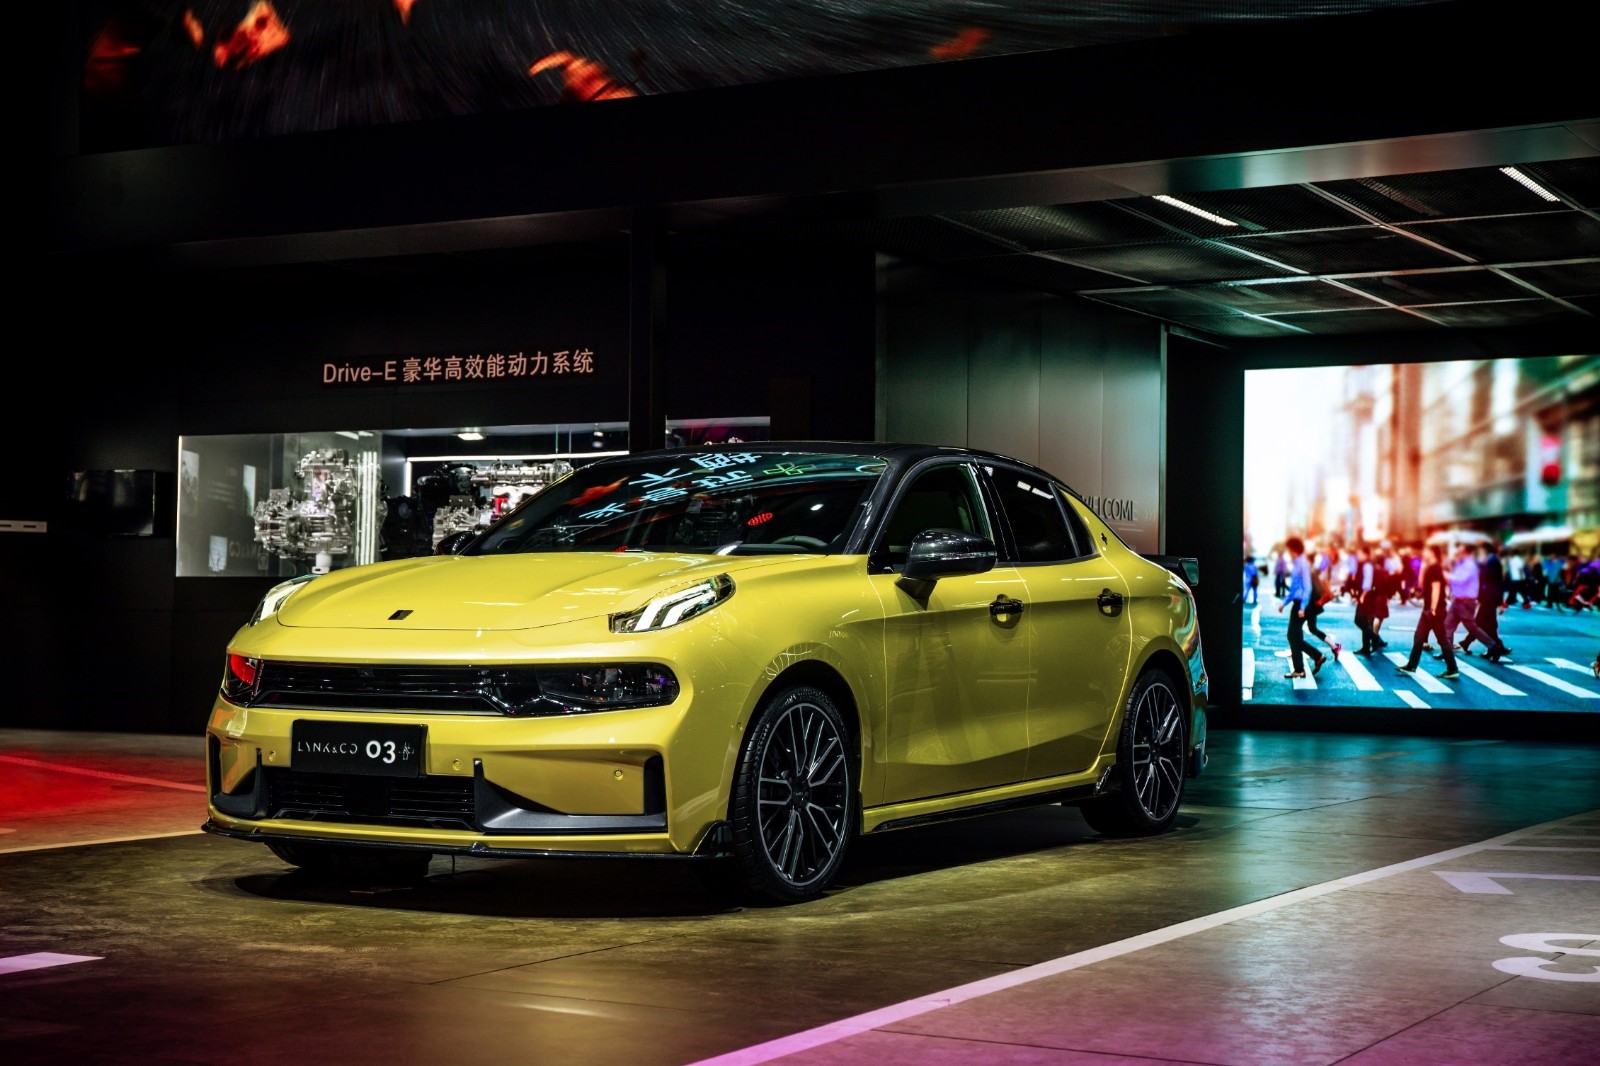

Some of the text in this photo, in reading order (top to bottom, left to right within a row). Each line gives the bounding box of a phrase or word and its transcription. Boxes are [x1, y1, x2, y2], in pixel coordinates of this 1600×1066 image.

[323, 348, 594, 383] Drive-E 豪华高效能动力系统
[366, 740, 396, 764] 03
